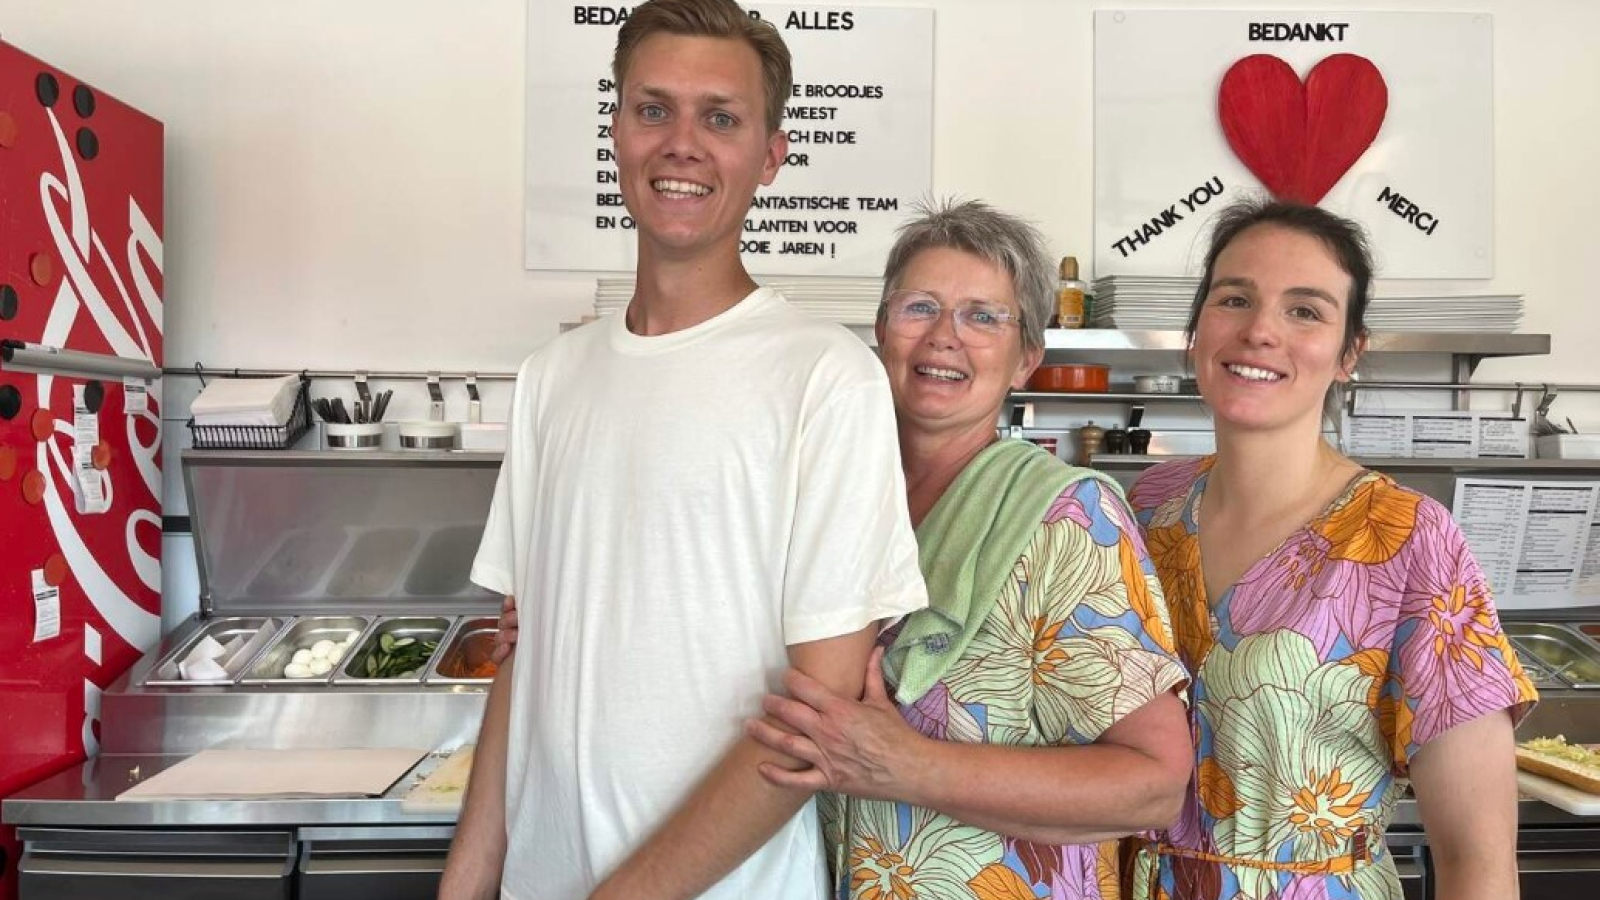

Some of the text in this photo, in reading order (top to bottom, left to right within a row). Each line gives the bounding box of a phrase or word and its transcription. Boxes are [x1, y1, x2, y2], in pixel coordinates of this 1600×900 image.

[574, 6, 854, 30] BEDA ALLES
[1249, 22, 1349, 41] BEDANKT
[805, 84, 883, 98] BROODJES
[814, 131, 833, 143] EN
[836, 131, 856, 144] DE
[597, 169, 617, 183] EN
[751, 196, 849, 210] ANTASTISCHE
[857, 198, 898, 210] TEAM
[1377, 186, 1438, 235] MERCI
[597, 216, 615, 229] EN
[814, 221, 857, 233] VOOR
[1111, 176, 1224, 257] THANK YOU
[779, 241, 824, 255] JAREN
[831, 242, 836, 258] !
